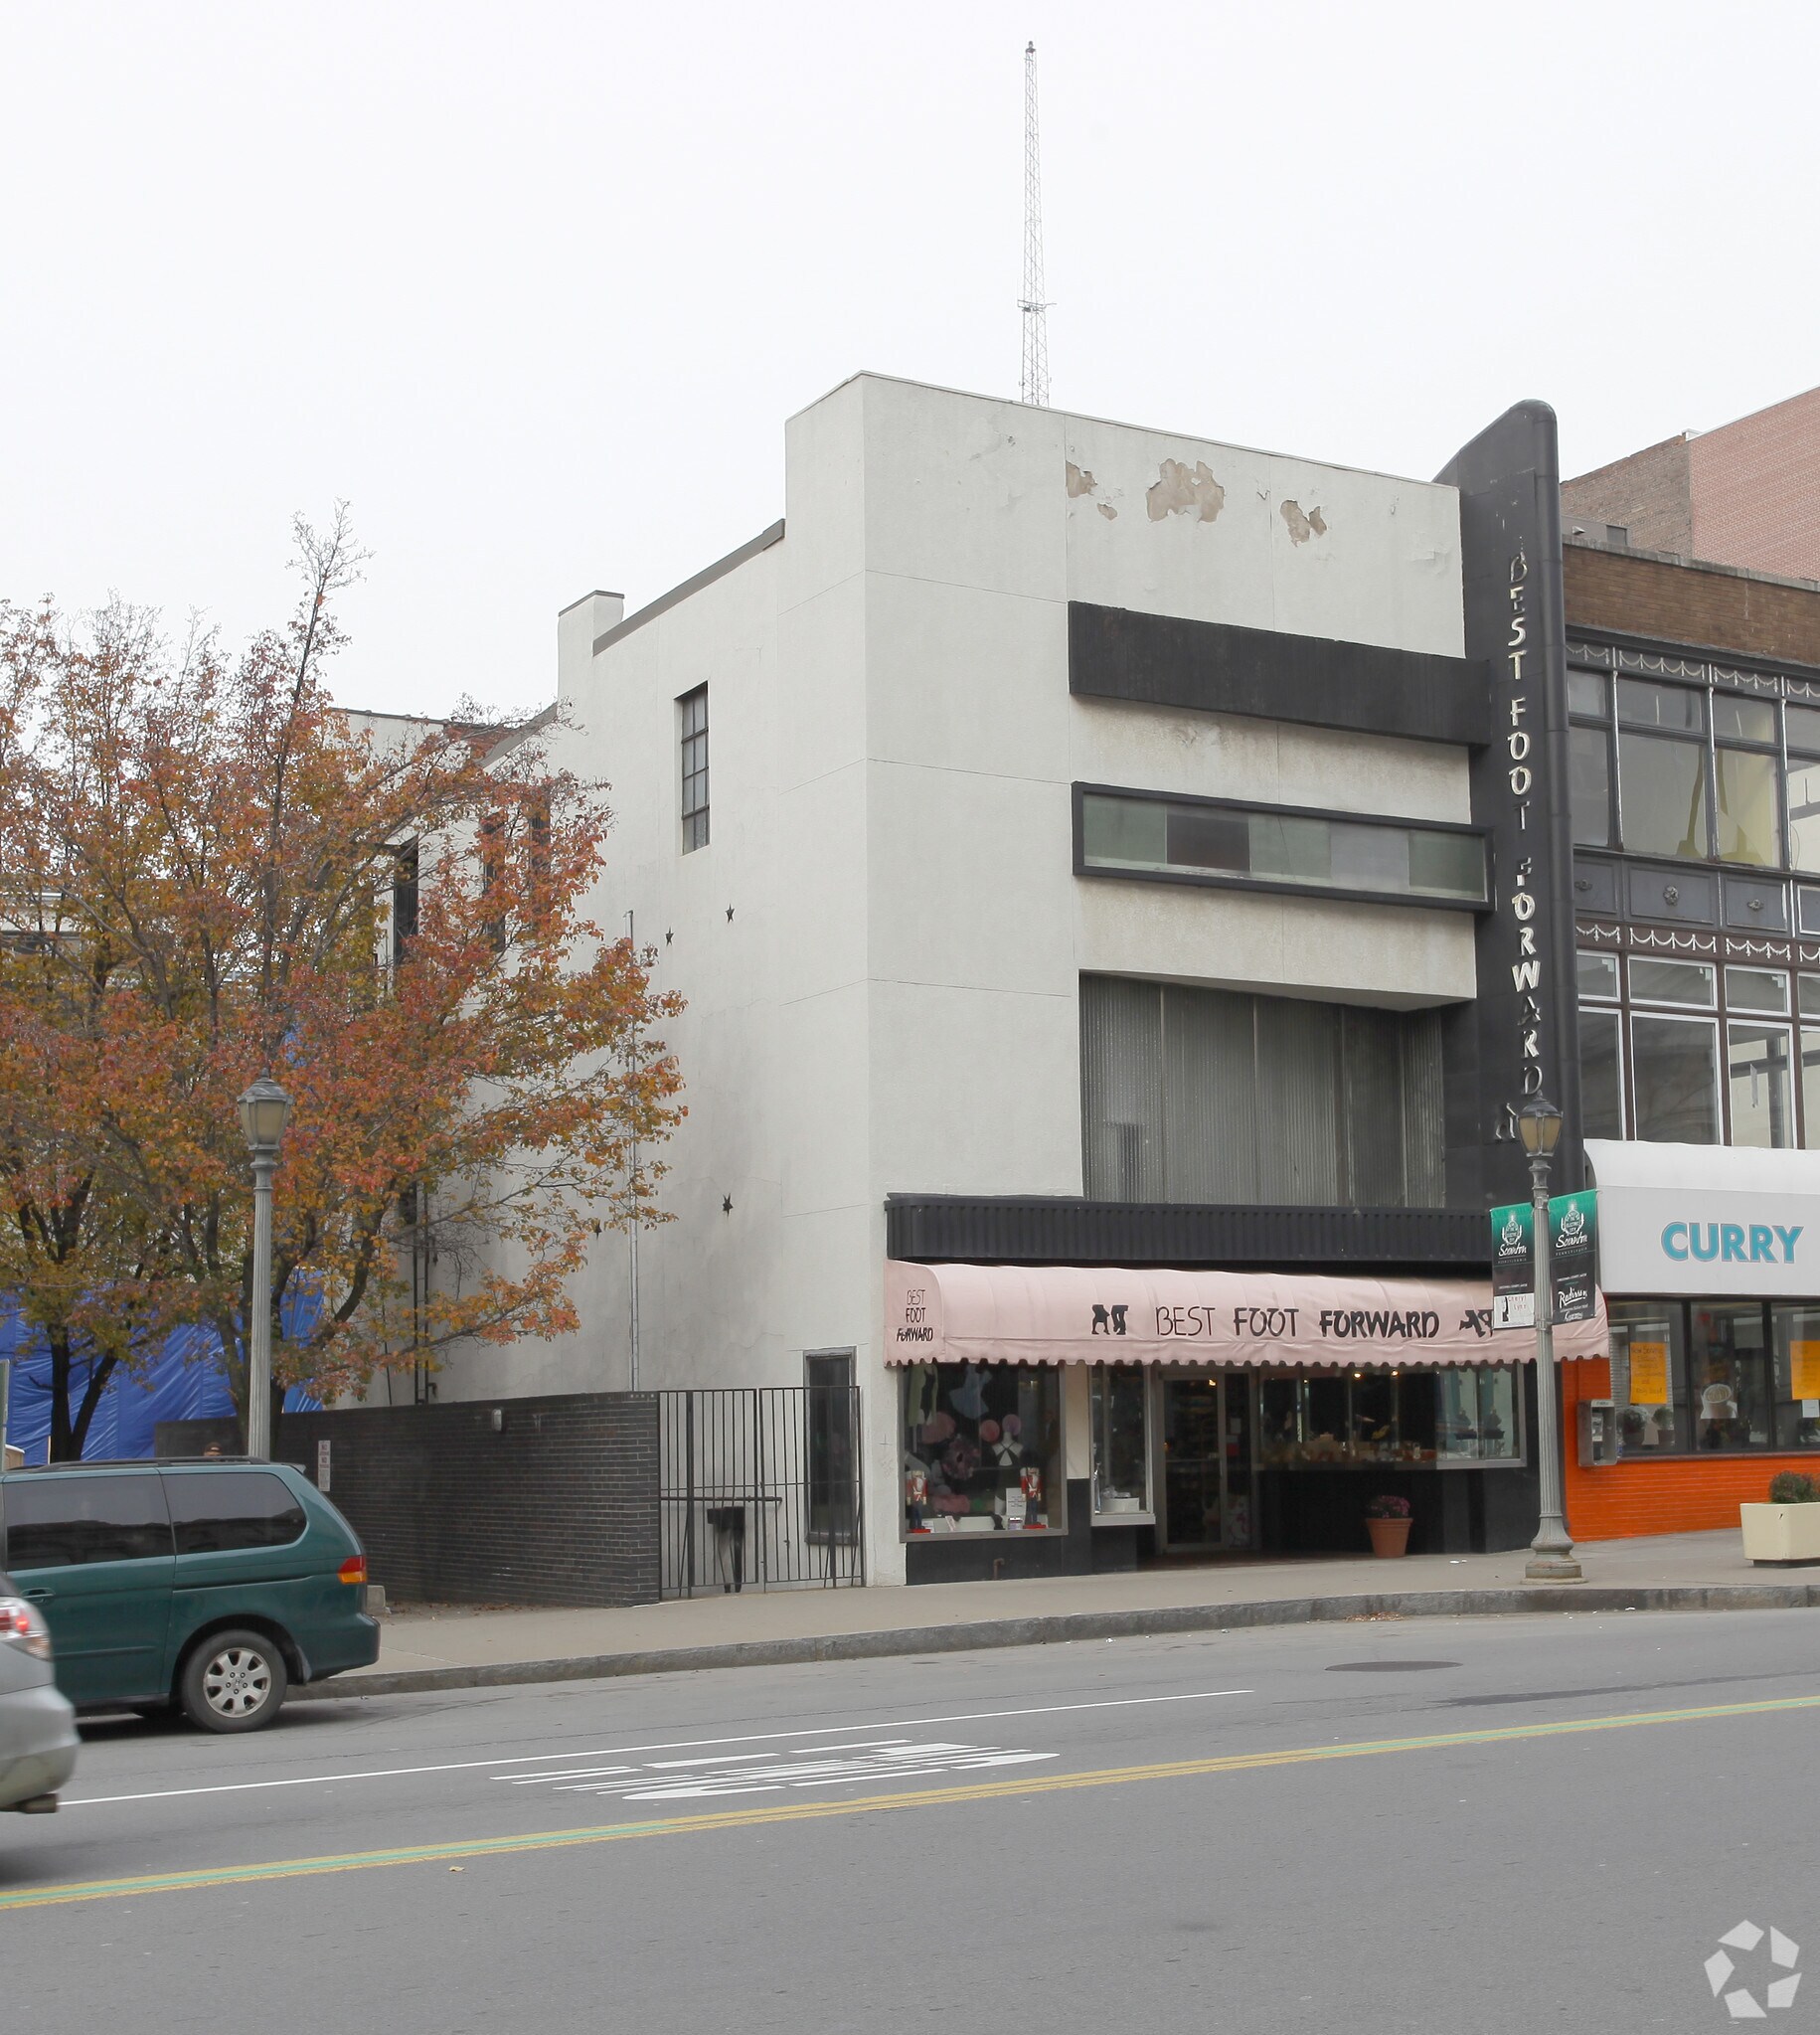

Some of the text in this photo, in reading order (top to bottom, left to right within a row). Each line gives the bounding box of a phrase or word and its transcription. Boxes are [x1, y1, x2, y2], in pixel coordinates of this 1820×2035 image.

[1507, 551, 1543, 1096] BEST FOOT FORWARD
[1661, 1221, 1804, 1264] CURRY
[907, 1288, 926, 1305] BEST
[906, 1307, 926, 1323] FOOT
[1155, 1306, 1440, 1338] BEST FOOT FORWARD
